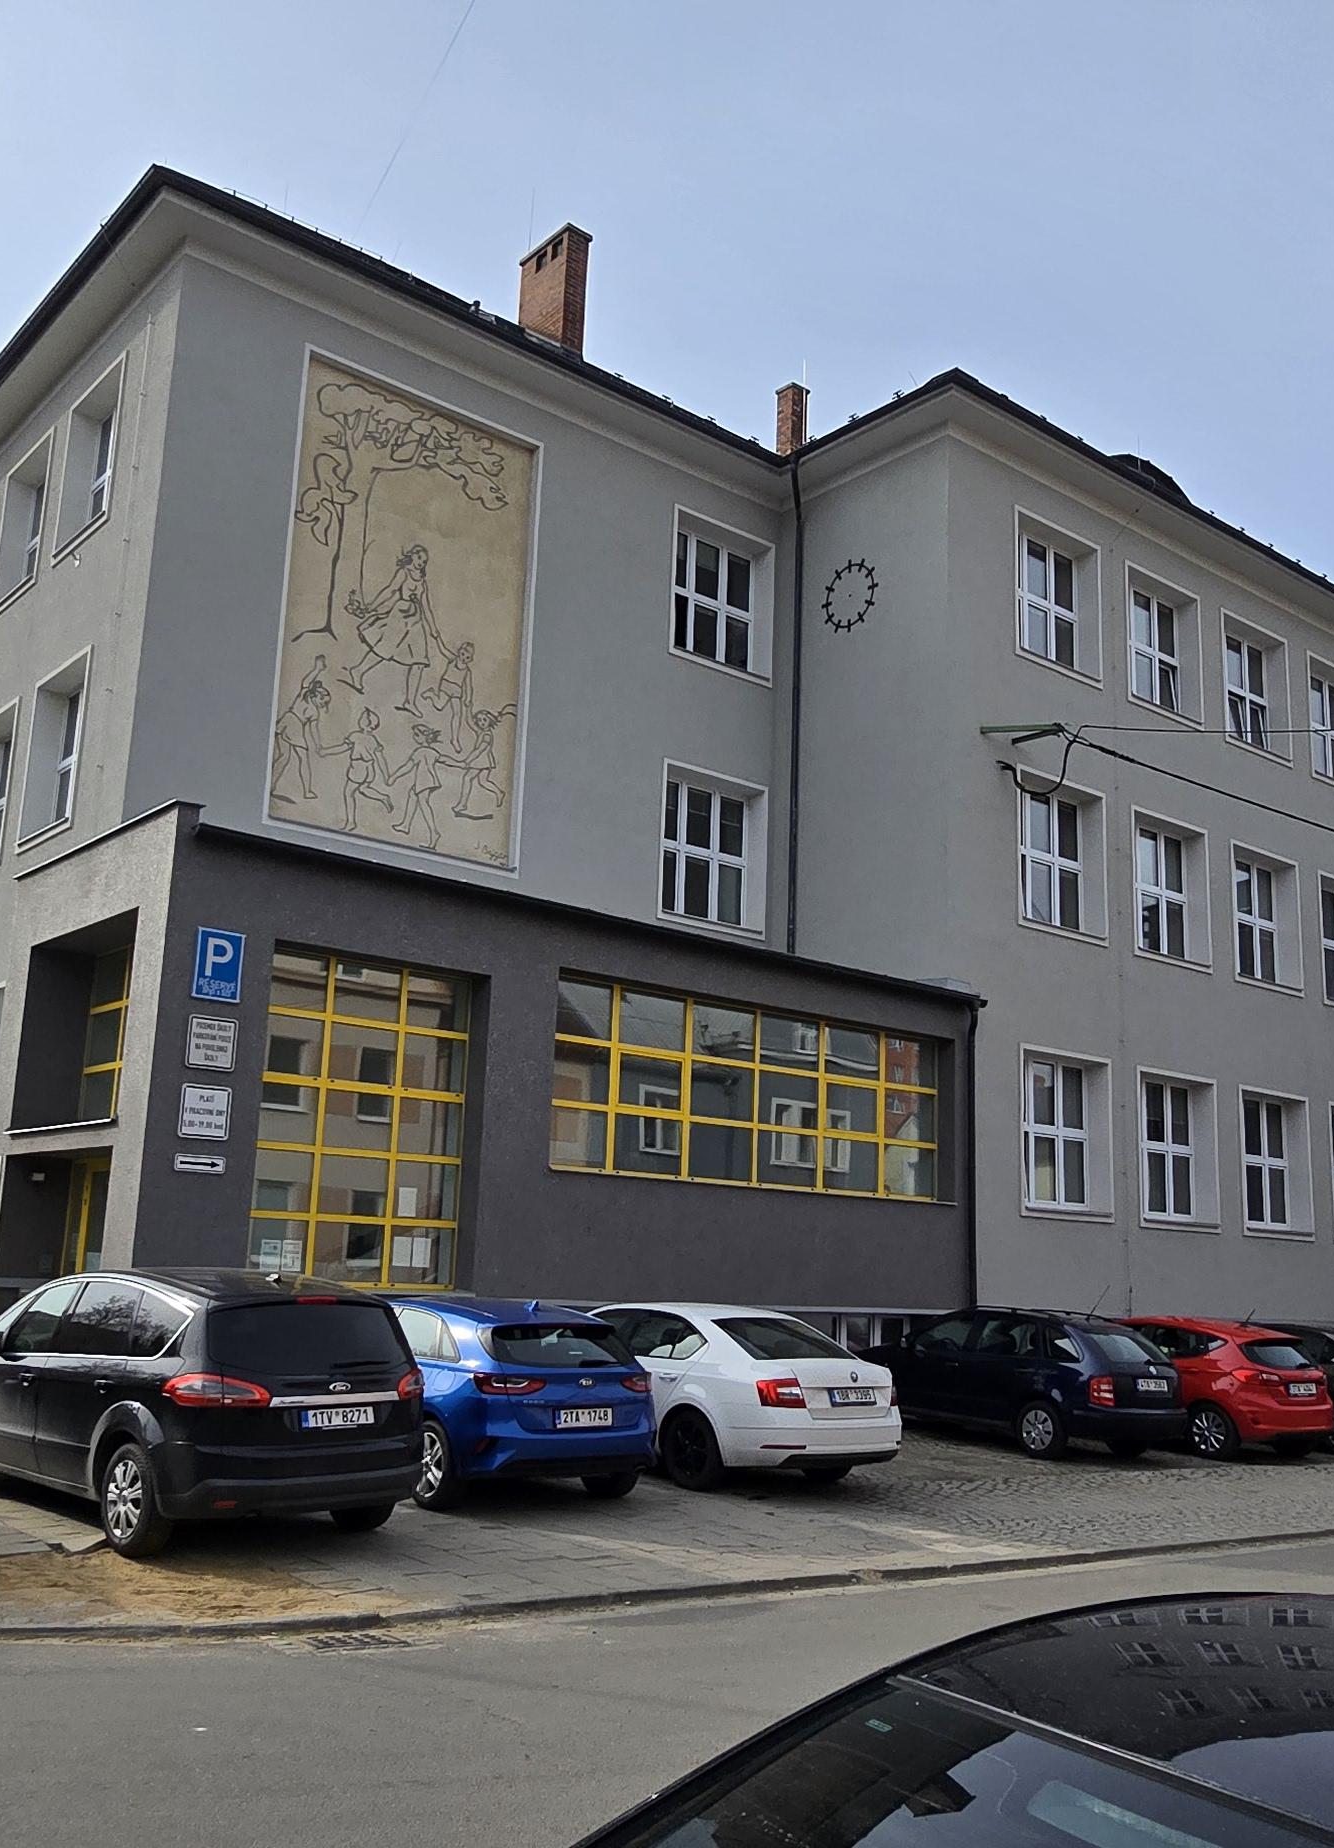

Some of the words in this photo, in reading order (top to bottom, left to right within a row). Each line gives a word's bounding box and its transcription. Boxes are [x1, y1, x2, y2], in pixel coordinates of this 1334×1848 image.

[204, 937, 234, 977] P
[312, 1411, 333, 1425] 1TV
[341, 1409, 370, 1423] 8271
[563, 1410, 580, 1423] 2TA
[587, 1410, 609, 1422] 1748
